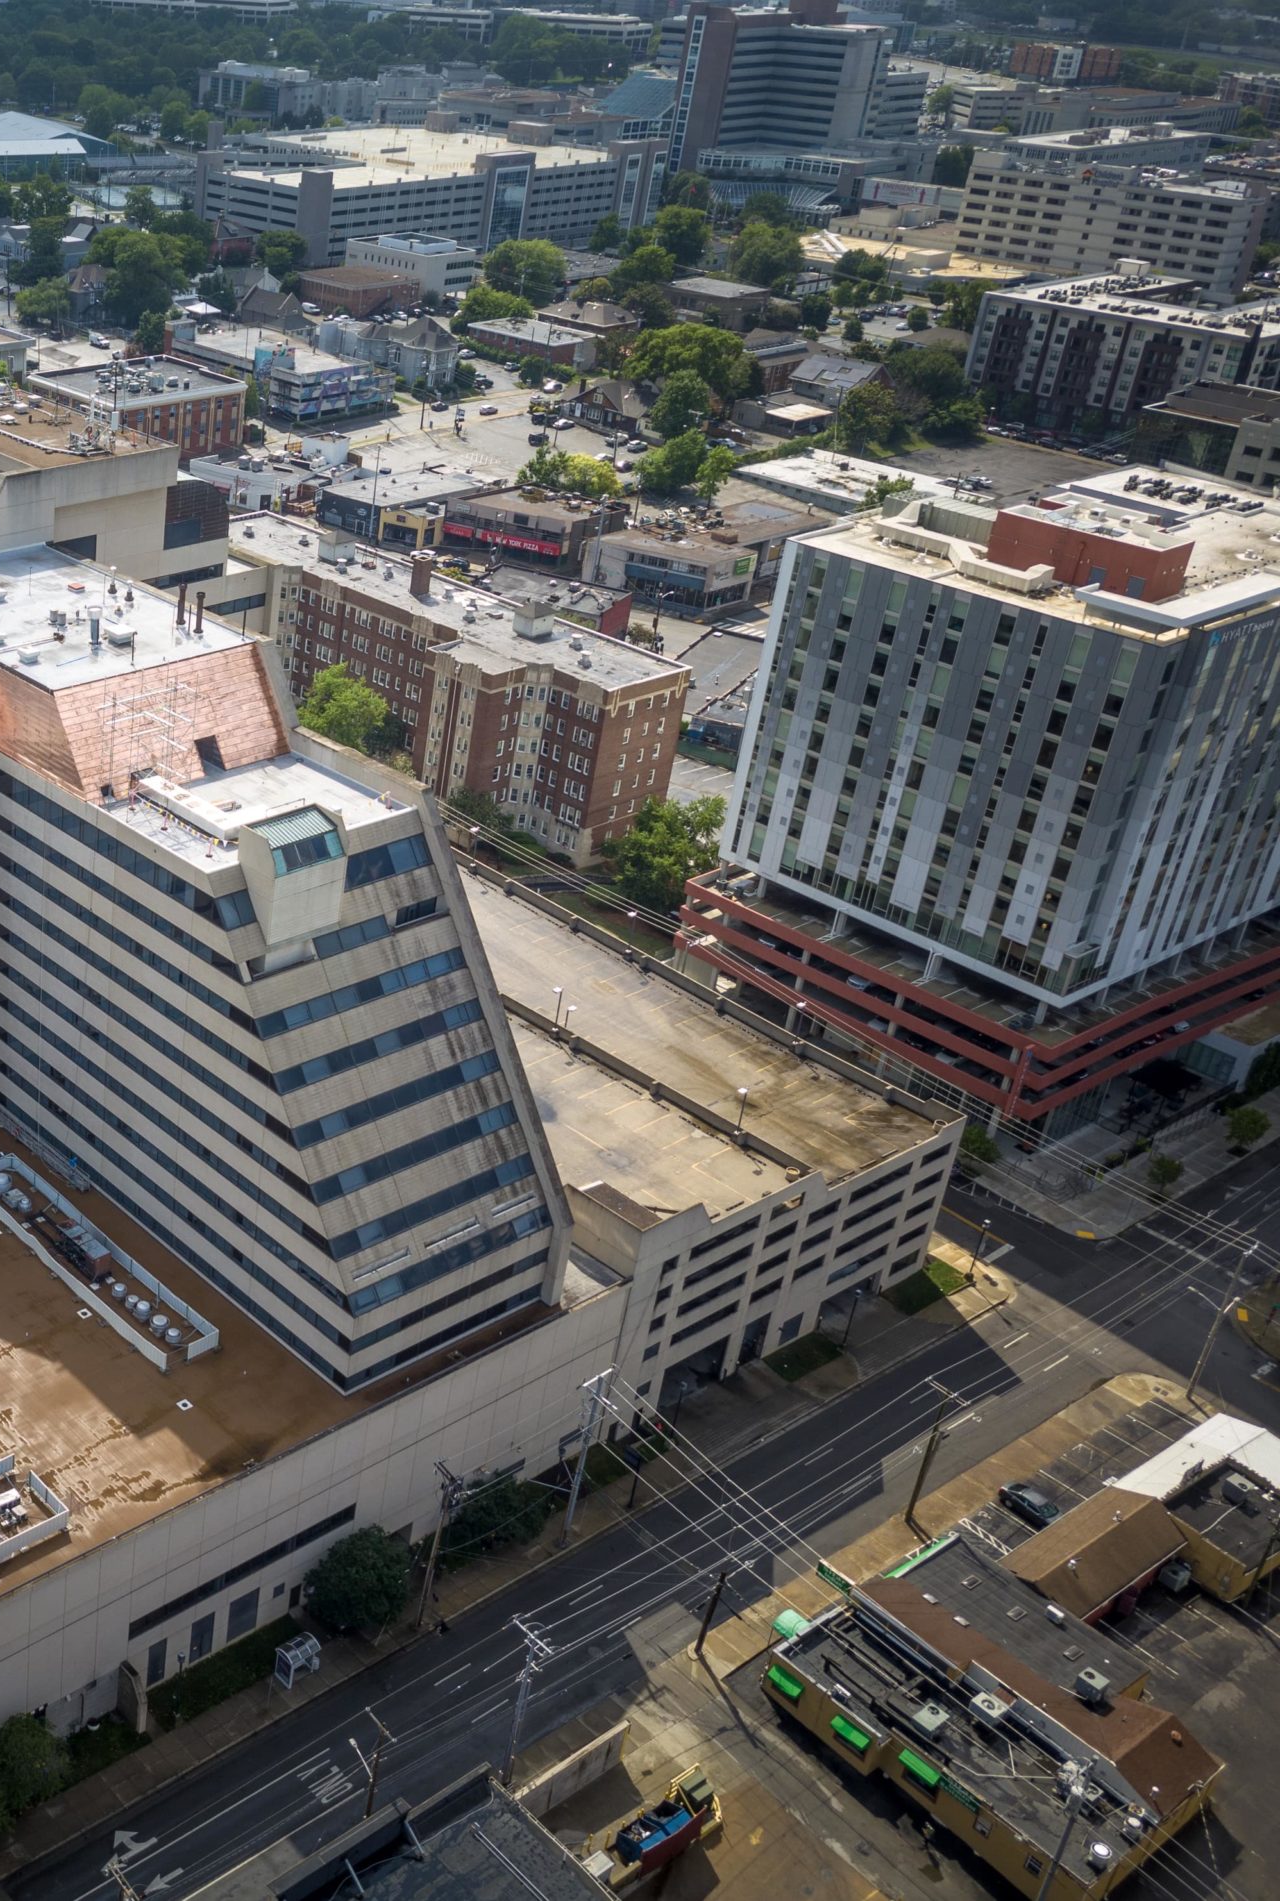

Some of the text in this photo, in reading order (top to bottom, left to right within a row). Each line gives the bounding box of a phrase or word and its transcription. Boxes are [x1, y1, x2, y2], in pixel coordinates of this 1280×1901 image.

[509, 539, 523, 548] YORK
[523, 542, 539, 552] PIZZA
[1221, 622, 1255, 643] HYATT
[296, 1759, 353, 1804] ONLY
